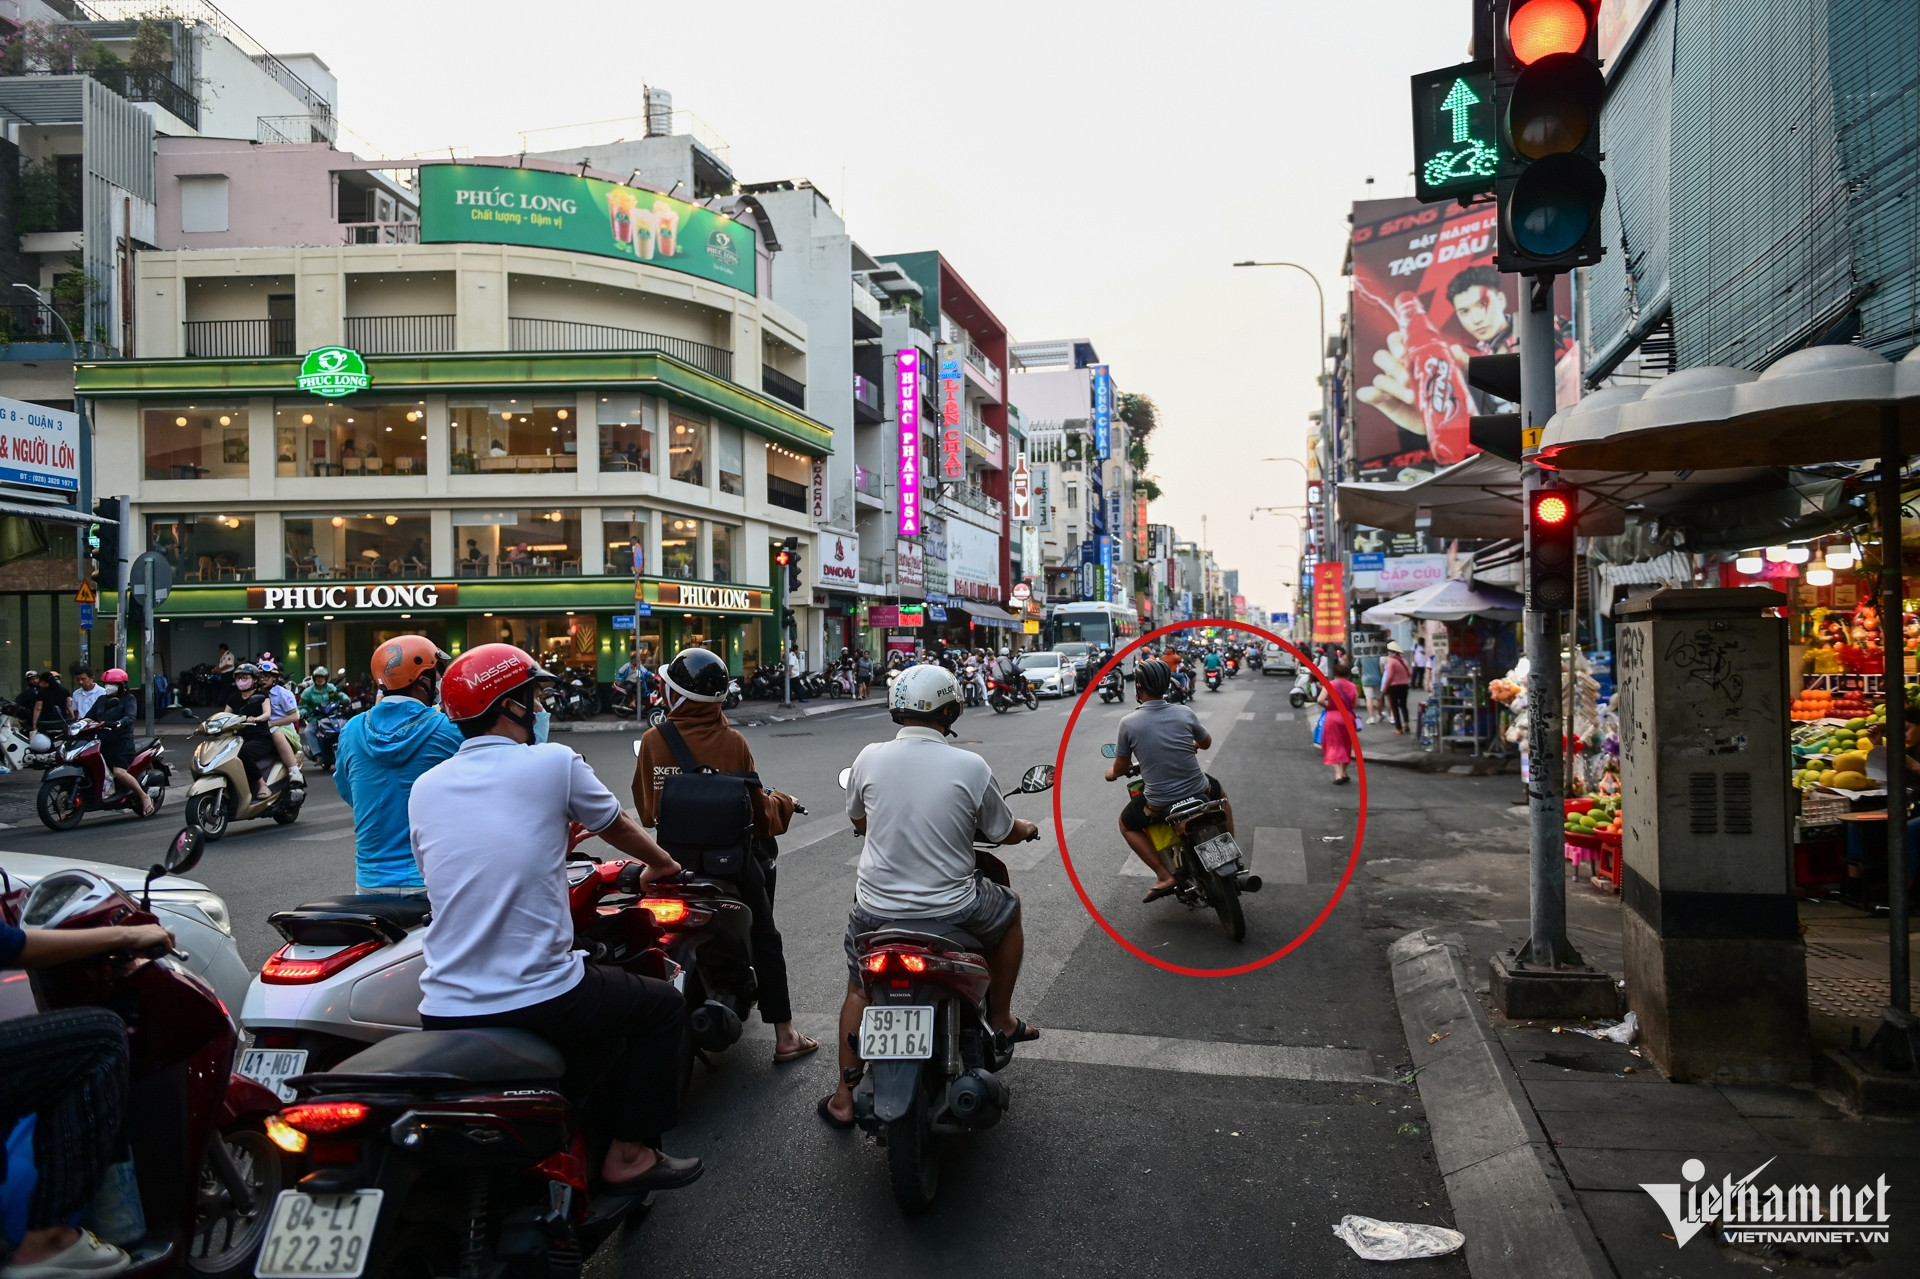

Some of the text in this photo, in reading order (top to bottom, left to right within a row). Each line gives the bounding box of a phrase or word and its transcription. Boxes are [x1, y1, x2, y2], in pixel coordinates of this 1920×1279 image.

[455, 186, 578, 215] PHÚC LONG
[471, 208, 493, 221] Chất
[495, 210, 521, 225] lượng
[1388, 233, 1489, 277] TẠO DẤU
[334, 375, 367, 387] LONG
[1097, 376, 1108, 414] LONG
[10, 410, 17, 422] 8
[28, 415, 54, 430] QUẬN
[57, 420, 63, 431] 3
[1528, 430, 1537, 445] 1
[12, 435, 49, 466] NGƯỜI
[52, 440, 75, 471] LỚN
[902, 432, 915, 486] PHÁT
[902, 492, 916, 532] USA
[264, 585, 438, 609] PHUC LONG
[679, 585, 750, 609] PHUC LONG
[465, 653, 521, 690] Masstel
[936, 684, 955, 698] PILOT
[873, 1010, 921, 1032] 59-T1
[865, 1033, 928, 1056] 231.64
[286, 1196, 362, 1231] 84-L1
[268, 1235, 363, 1272] 122.39
